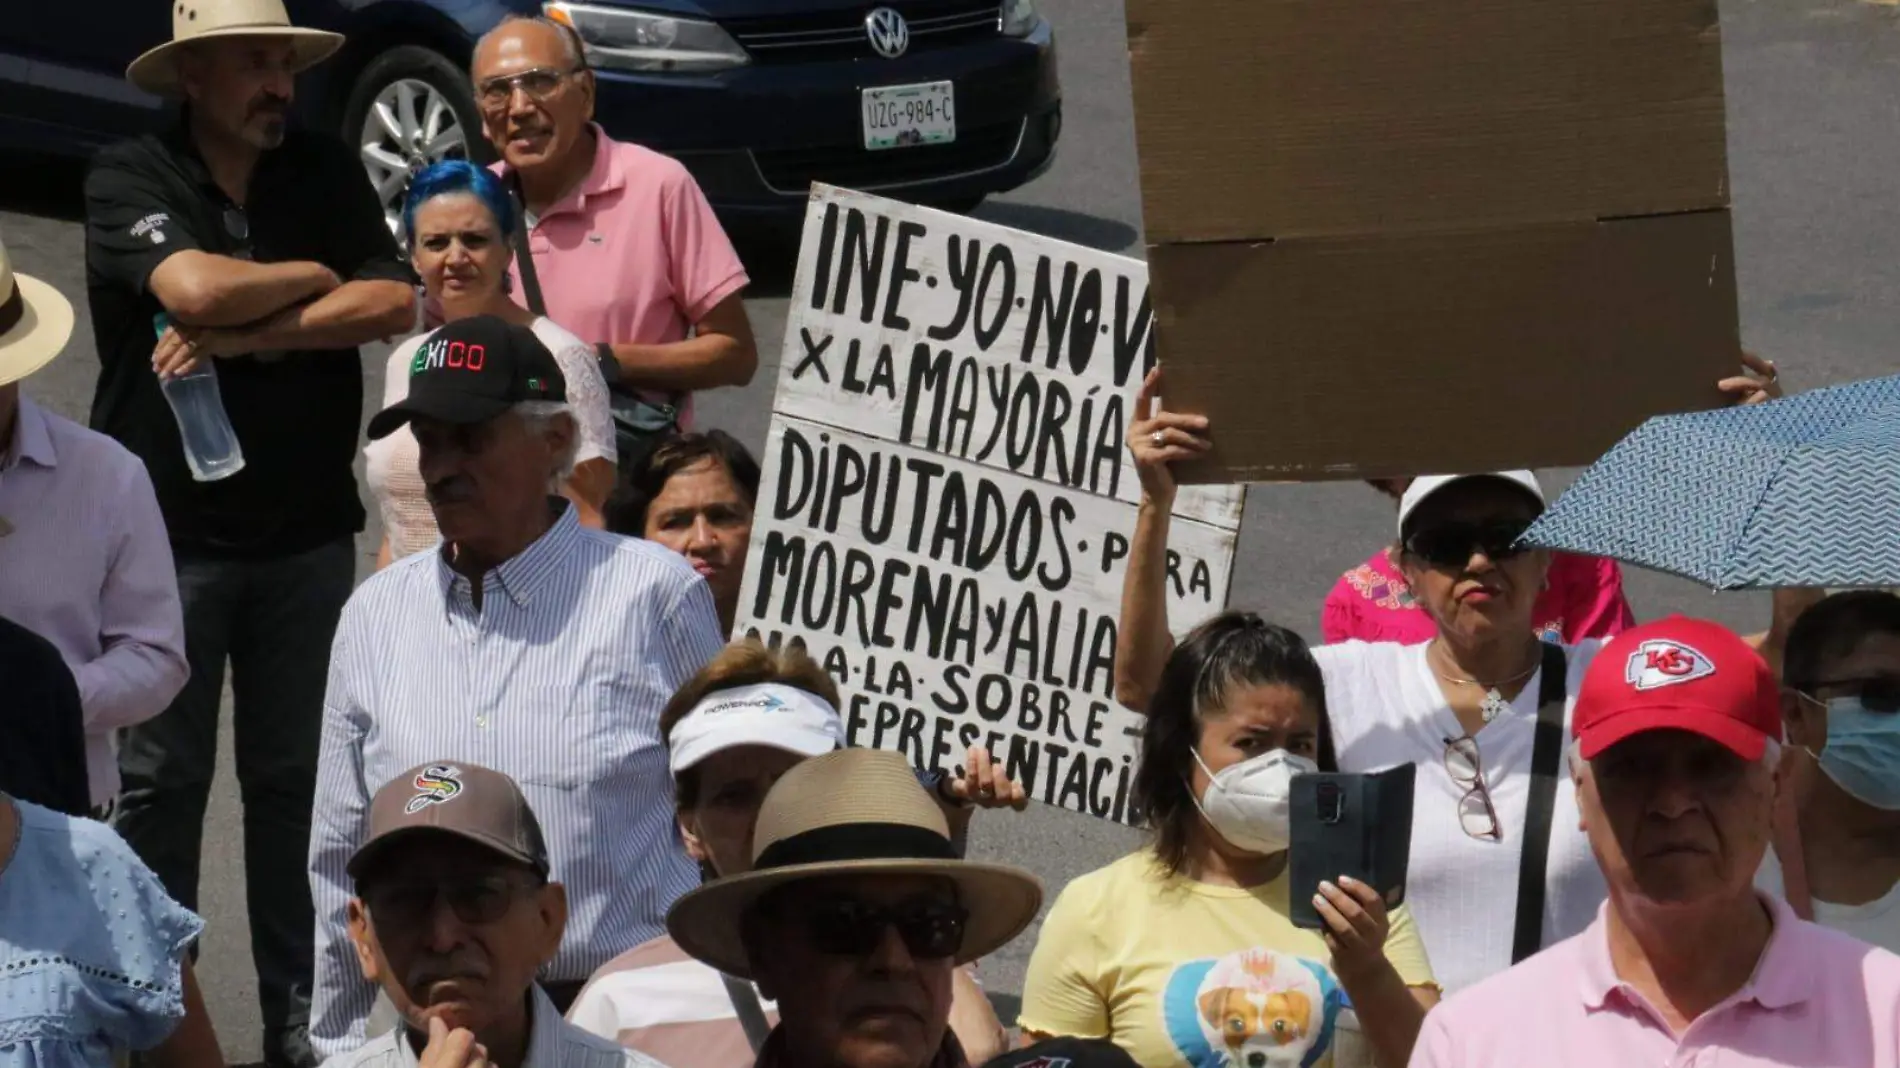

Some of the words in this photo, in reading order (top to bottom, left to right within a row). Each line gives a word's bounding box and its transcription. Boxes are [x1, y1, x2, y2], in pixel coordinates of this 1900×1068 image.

[867, 96, 951, 129] UZG-984-C
[1113, 274, 1156, 387] V
[792, 328, 833, 384] X
[841, 339, 896, 400] LA
[899, 342, 1125, 498] MAYORÍA
[752, 530, 979, 667] MORENA
[1004, 591, 1118, 696] ALIA
[1101, 531, 1212, 604] PRA
[863, 654, 913, 701] LA
[846, 692, 1150, 828] EPRESENTACi
